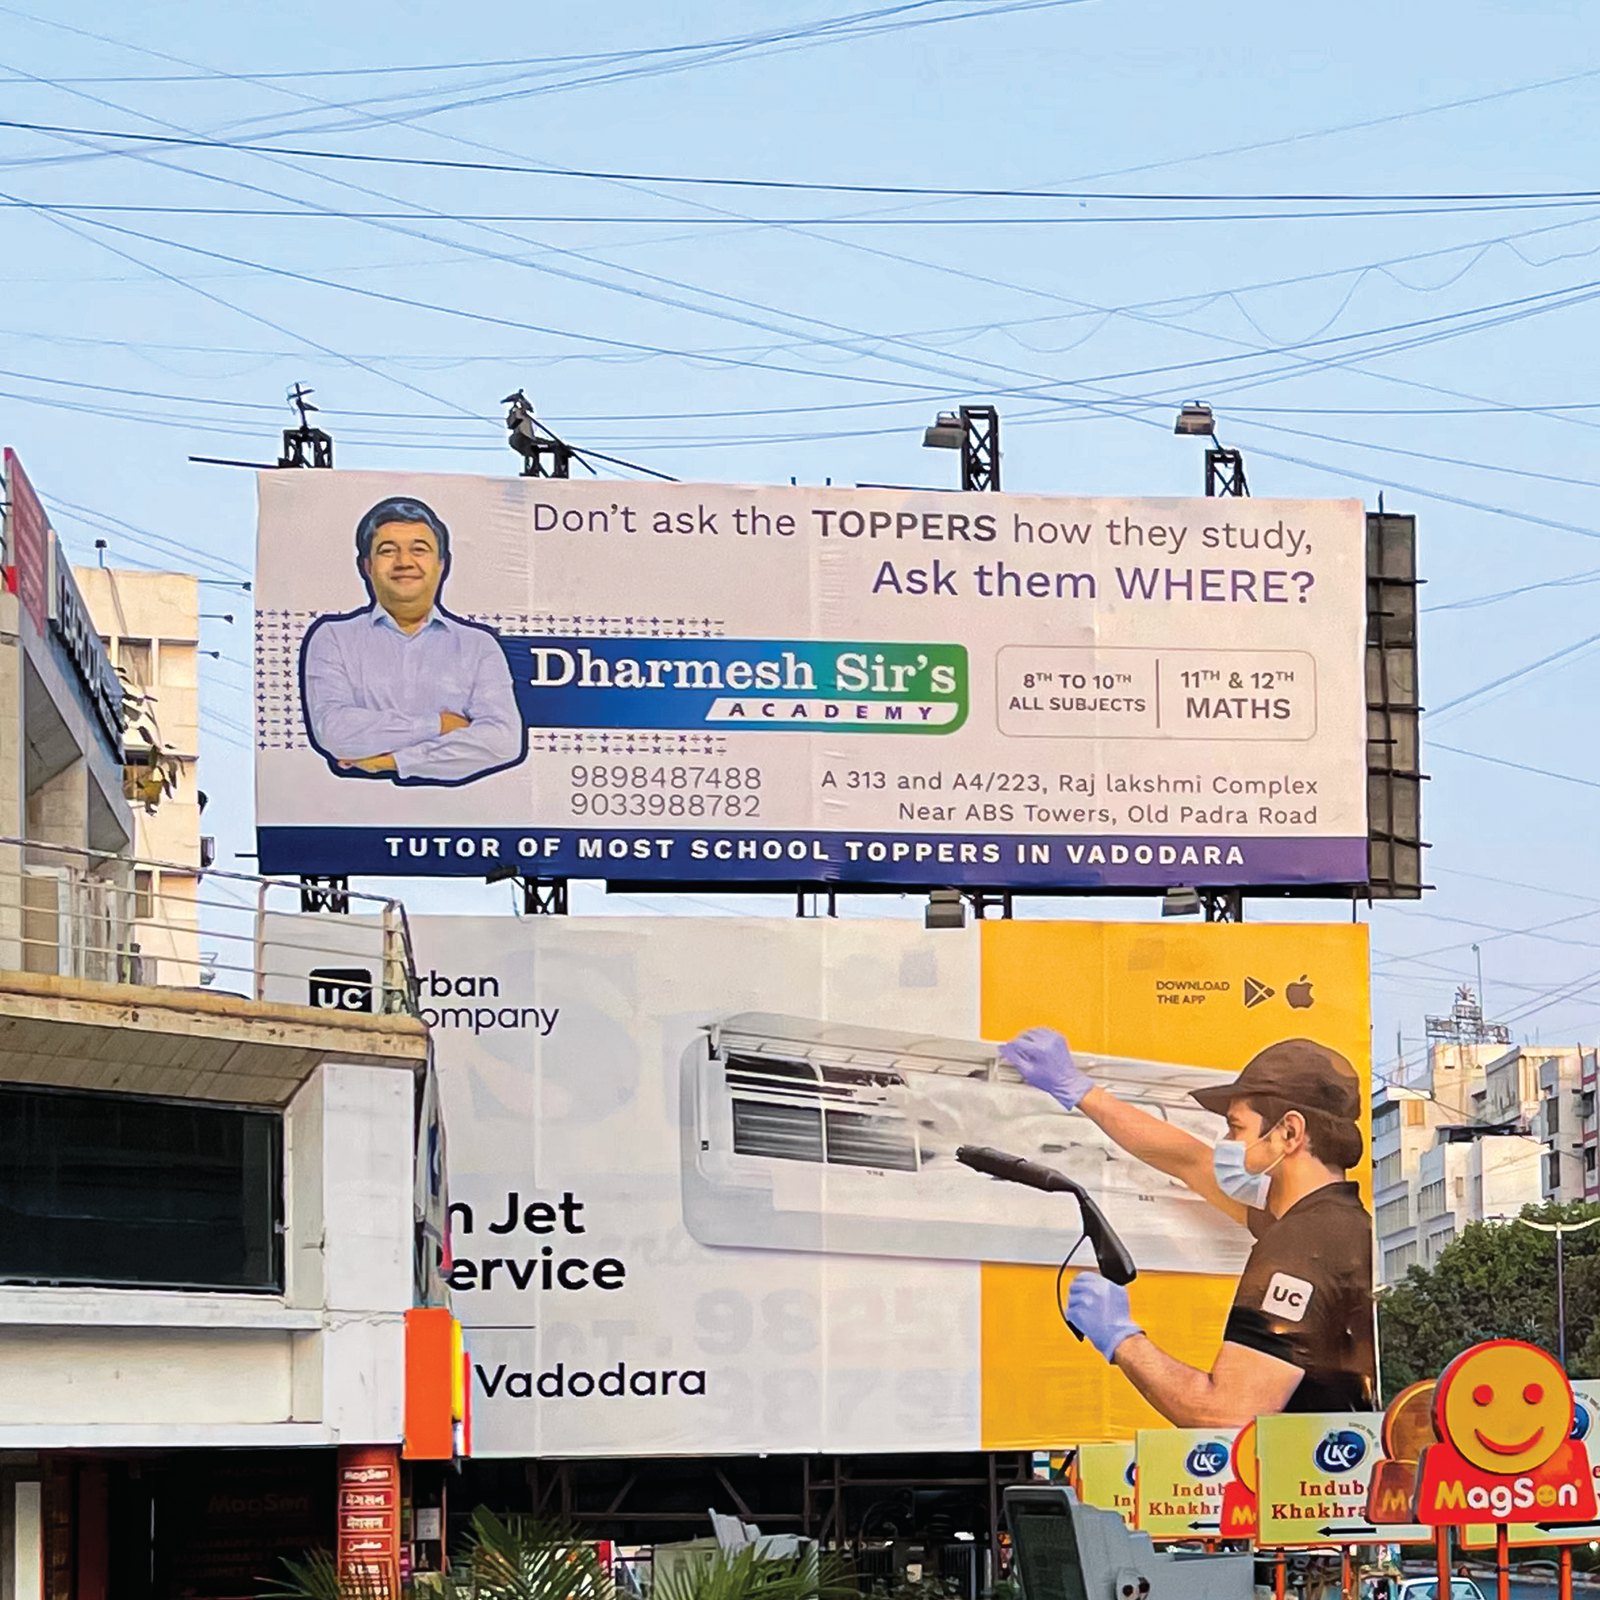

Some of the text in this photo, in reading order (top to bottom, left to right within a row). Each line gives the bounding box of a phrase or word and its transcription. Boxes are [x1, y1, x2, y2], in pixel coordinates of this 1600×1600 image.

[533, 503, 1313, 558] Don't ask the TOPPERS how they study,
[872, 559, 1315, 604] Ask them WHERE?
[529, 648, 957, 694] Dharmesh Sir's
[1022, 673, 1132, 690] 8TH TO 10TH
[1180, 670, 1295, 690] 11TH & 12TH
[728, 702, 933, 721] ACADEMY
[1008, 696, 1147, 713] ALL SUBJECTS
[1186, 698, 1291, 720] MATHS
[570, 765, 762, 789] 9898487488
[821, 771, 1319, 799] A 313 and A4/223, Raj lakshmi Complex
[570, 794, 761, 818] 9033988782
[899, 803, 1319, 825] Near ABS Towers, Old Padra Road
[385, 837, 1246, 866] TUTOR OF MOST SCHOOL TOPPERS IN VADODARA
[416, 970, 500, 998] rban
[1156, 980, 1230, 992] DOWNLOAD
[317, 987, 363, 1009] UC
[1156, 994, 1206, 1005] THE APP
[421, 1008, 560, 1036] ompany
[488, 1192, 586, 1235] Jet
[448, 1245, 626, 1291] ervice
[1272, 1286, 1303, 1308] UC
[474, 1363, 706, 1398] Vadodara
[1172, 1483, 1227, 1497] Indub
[1299, 1480, 1366, 1497] Indub
[1434, 1477, 1578, 1517] MagSon
[1149, 1502, 1221, 1516] Khakhr
[1271, 1503, 1367, 1520] Khakhra
